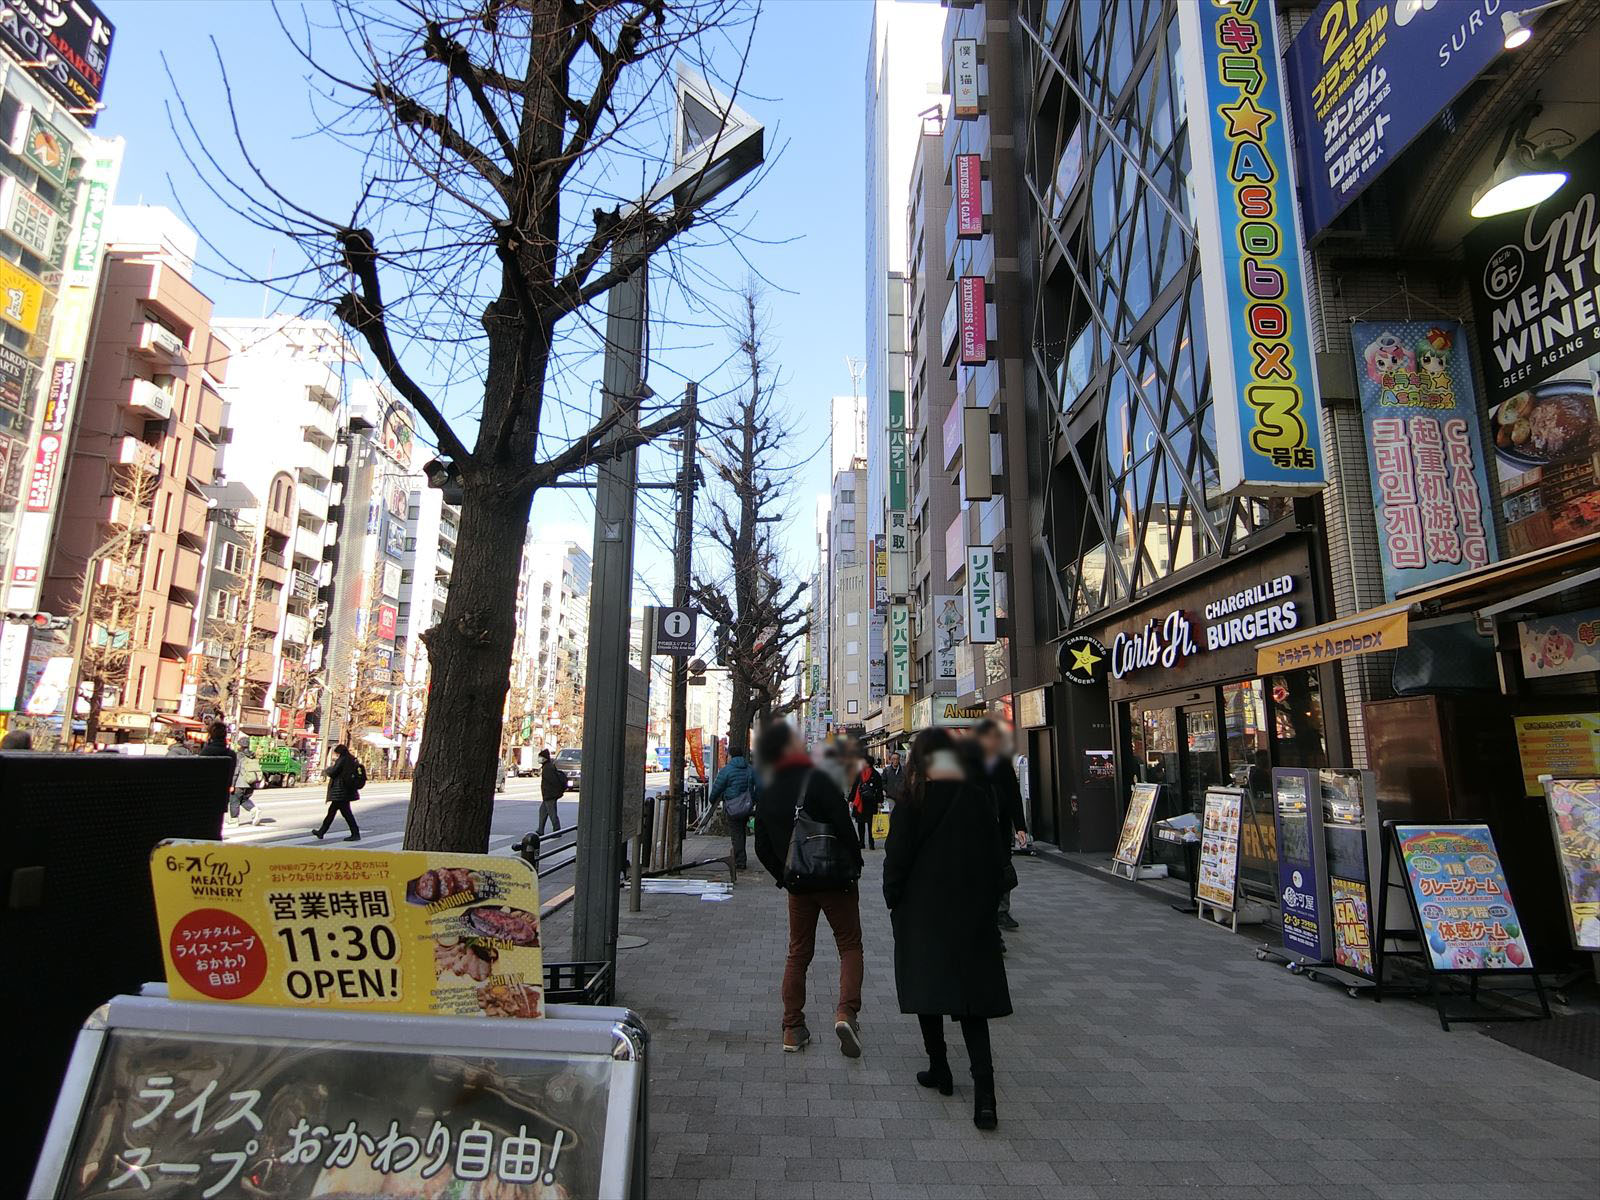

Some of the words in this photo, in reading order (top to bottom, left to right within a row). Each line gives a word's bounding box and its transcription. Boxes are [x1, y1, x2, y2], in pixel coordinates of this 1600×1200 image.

[1312, 5, 1388, 110] プラモデル
[1324, 65, 1387, 147] ガンダム
[1328, 113, 1391, 189] ロボット
[960, 156, 970, 199] PRINCESS
[1490, 264, 1518, 293] 6F
[1493, 253, 1586, 342] MEAT
[963, 278, 974, 324] PRINCESS
[1541, 336, 1584, 369] AGING
[890, 414, 906, 486] リバティー
[1410, 417, 1461, 562] 起重机游戏
[892, 513, 906, 550] 買取
[971, 553, 991, 635] リバティー
[1204, 575, 1293, 620] CHARGRILLED
[1112, 618, 1161, 680] Carl's
[1162, 610, 1197, 669] Jr.
[1206, 601, 1298, 651] BURGERS
[893, 611, 908, 688] リバティー
[166, 856, 185, 873] 6F
[191, 876, 225, 886] MEAT
[192, 886, 243, 898] WINERY
[269, 890, 390, 921] 営業時間
[1420, 878, 1503, 896] クレーンゲーム
[176, 936, 256, 958] ライス・スープ
[182, 926, 241, 941] ランチタイム
[278, 924, 398, 963] 11:30
[1438, 920, 1510, 941] 体感ゲーム
[196, 954, 246, 971] おかわり
[208, 973, 241, 986] 自由!
[286, 968, 398, 1000] OPEN!
[132, 1077, 264, 1134] ライス
[108, 1139, 260, 1200] スープ
[279, 1117, 565, 1185] おかわり自由!
